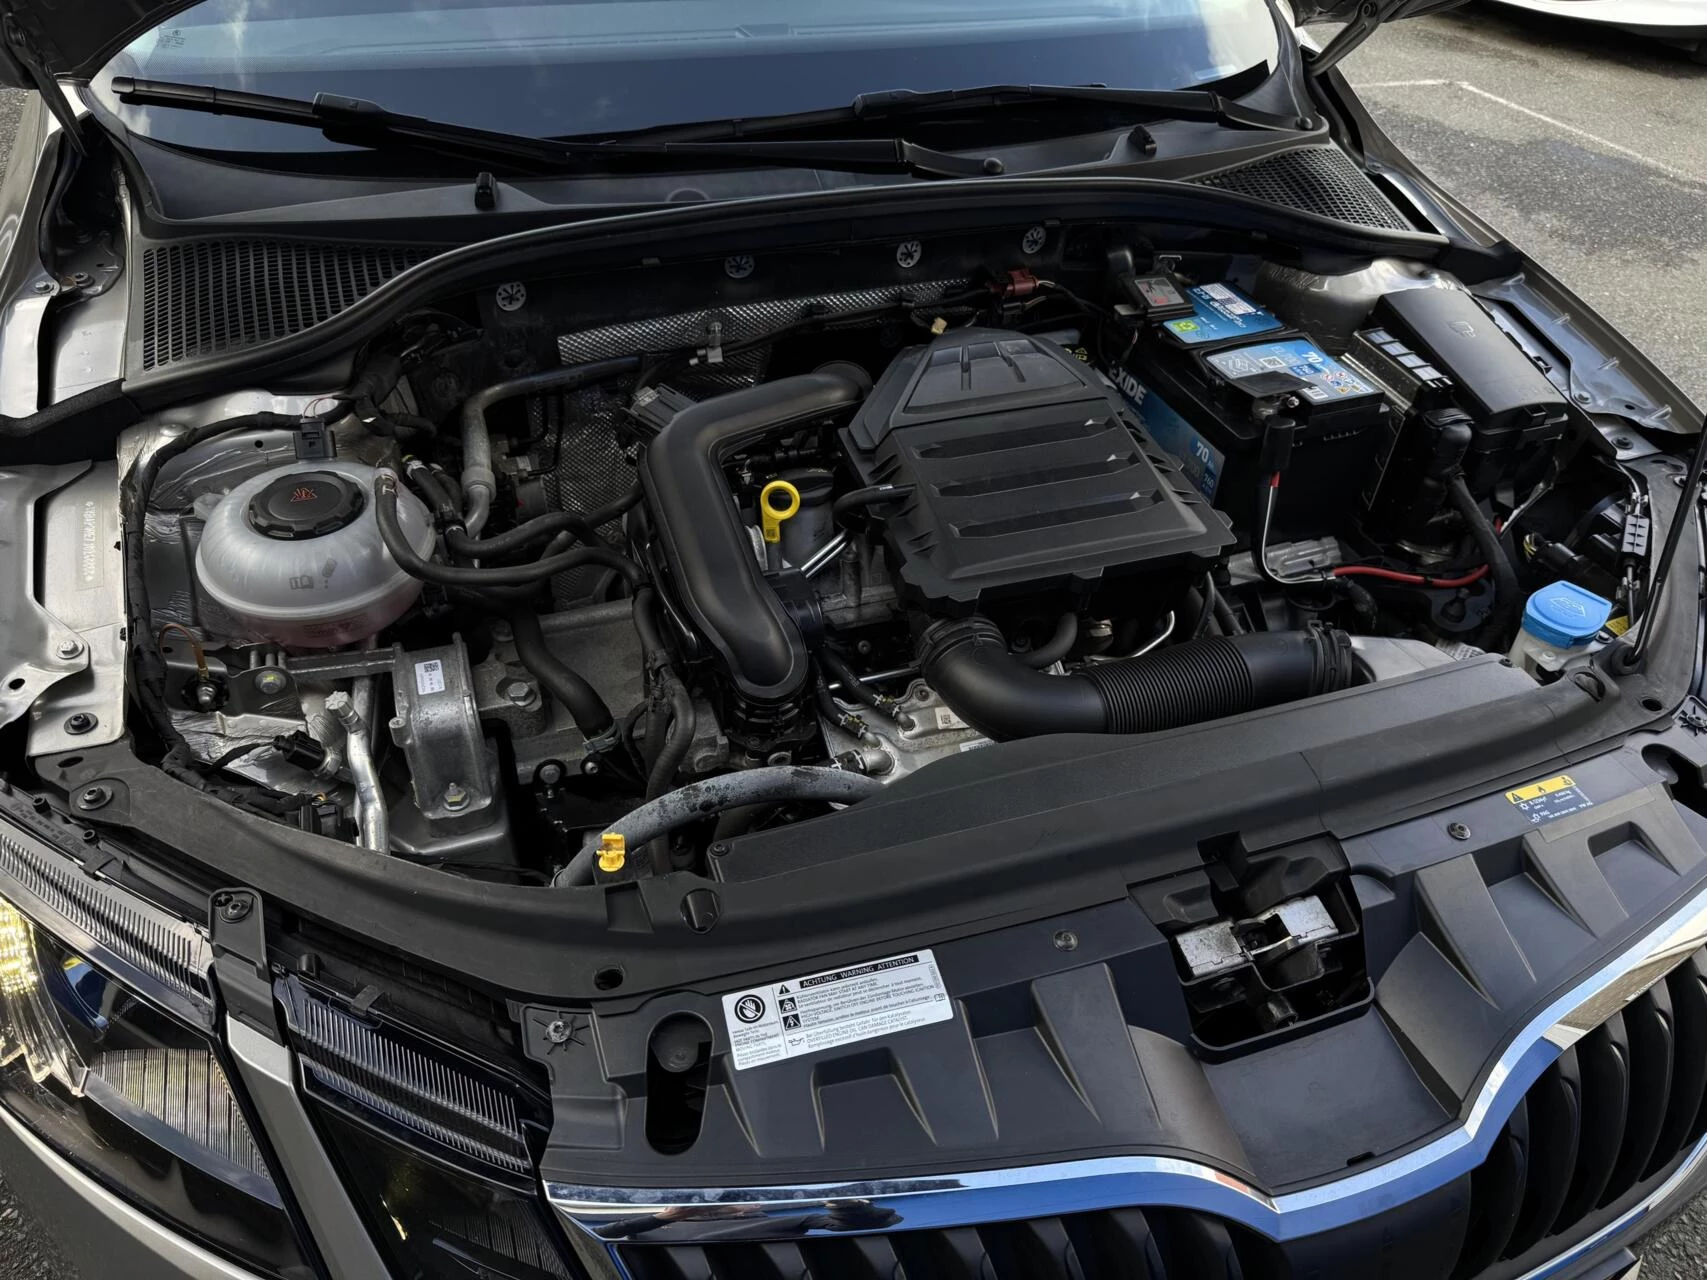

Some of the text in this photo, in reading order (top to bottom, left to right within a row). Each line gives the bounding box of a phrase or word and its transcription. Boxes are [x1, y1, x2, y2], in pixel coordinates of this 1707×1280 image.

[1301, 351, 1323, 363] 70
[1109, 366, 1147, 406] EXIDE
[1196, 441, 1210, 463] 70
[803, 957, 914, 988] ACHTUNG WARNING ATTENTION
